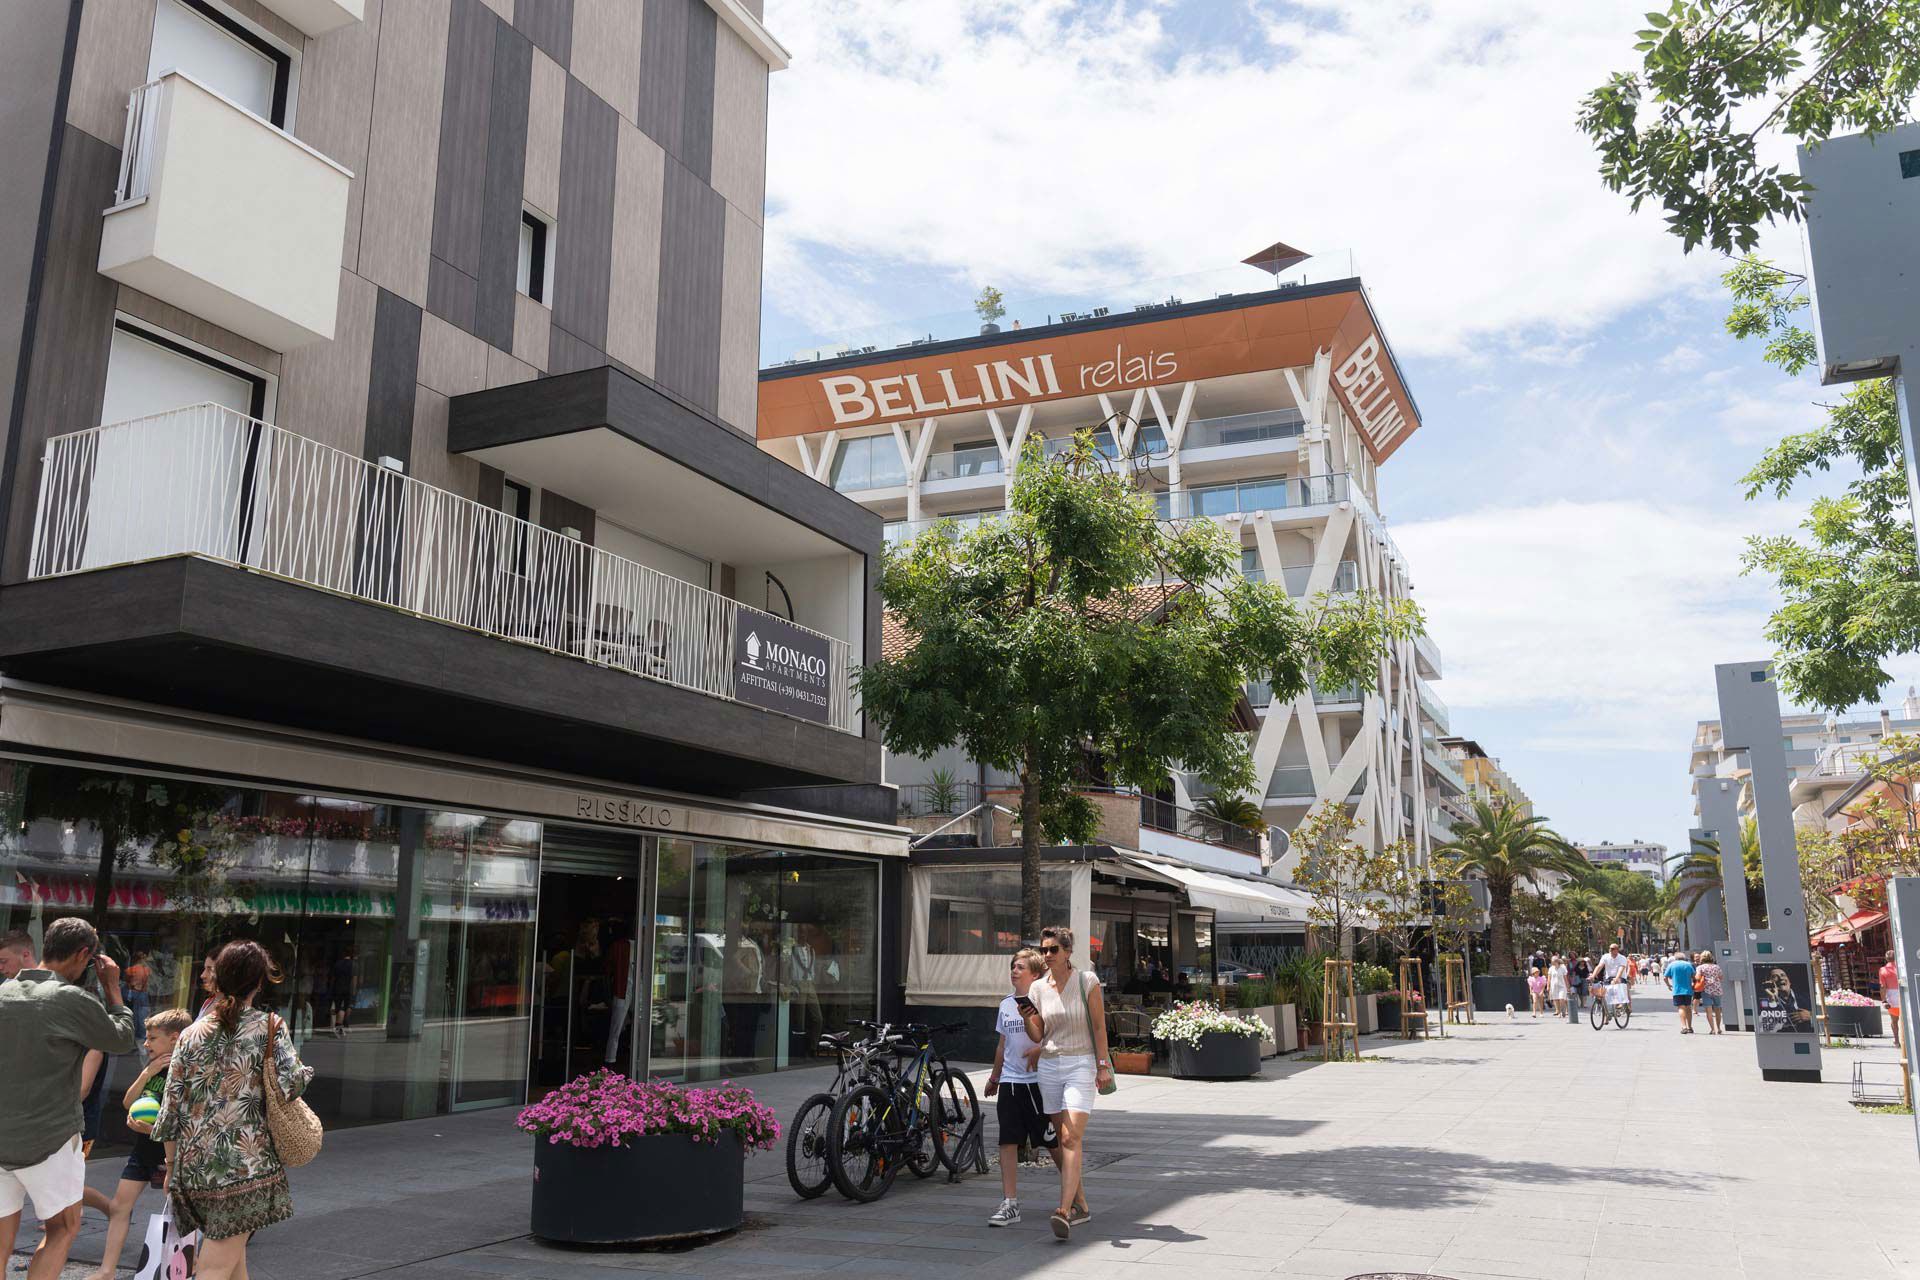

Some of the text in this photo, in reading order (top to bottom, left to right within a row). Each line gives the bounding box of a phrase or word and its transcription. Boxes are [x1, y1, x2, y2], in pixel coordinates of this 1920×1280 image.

[819, 343, 1178, 425] BELLINI relais
[1334, 332, 1407, 453] BELLINI
[766, 640, 826, 677] MONACO
[740, 672, 777, 692] AFFITTASI
[778, 682, 795, 699] (+39)
[765, 661, 826, 688] APARTMENTS
[1004, 1019, 1024, 1027] Emira
[1760, 1010, 1787, 1018] ONDE
